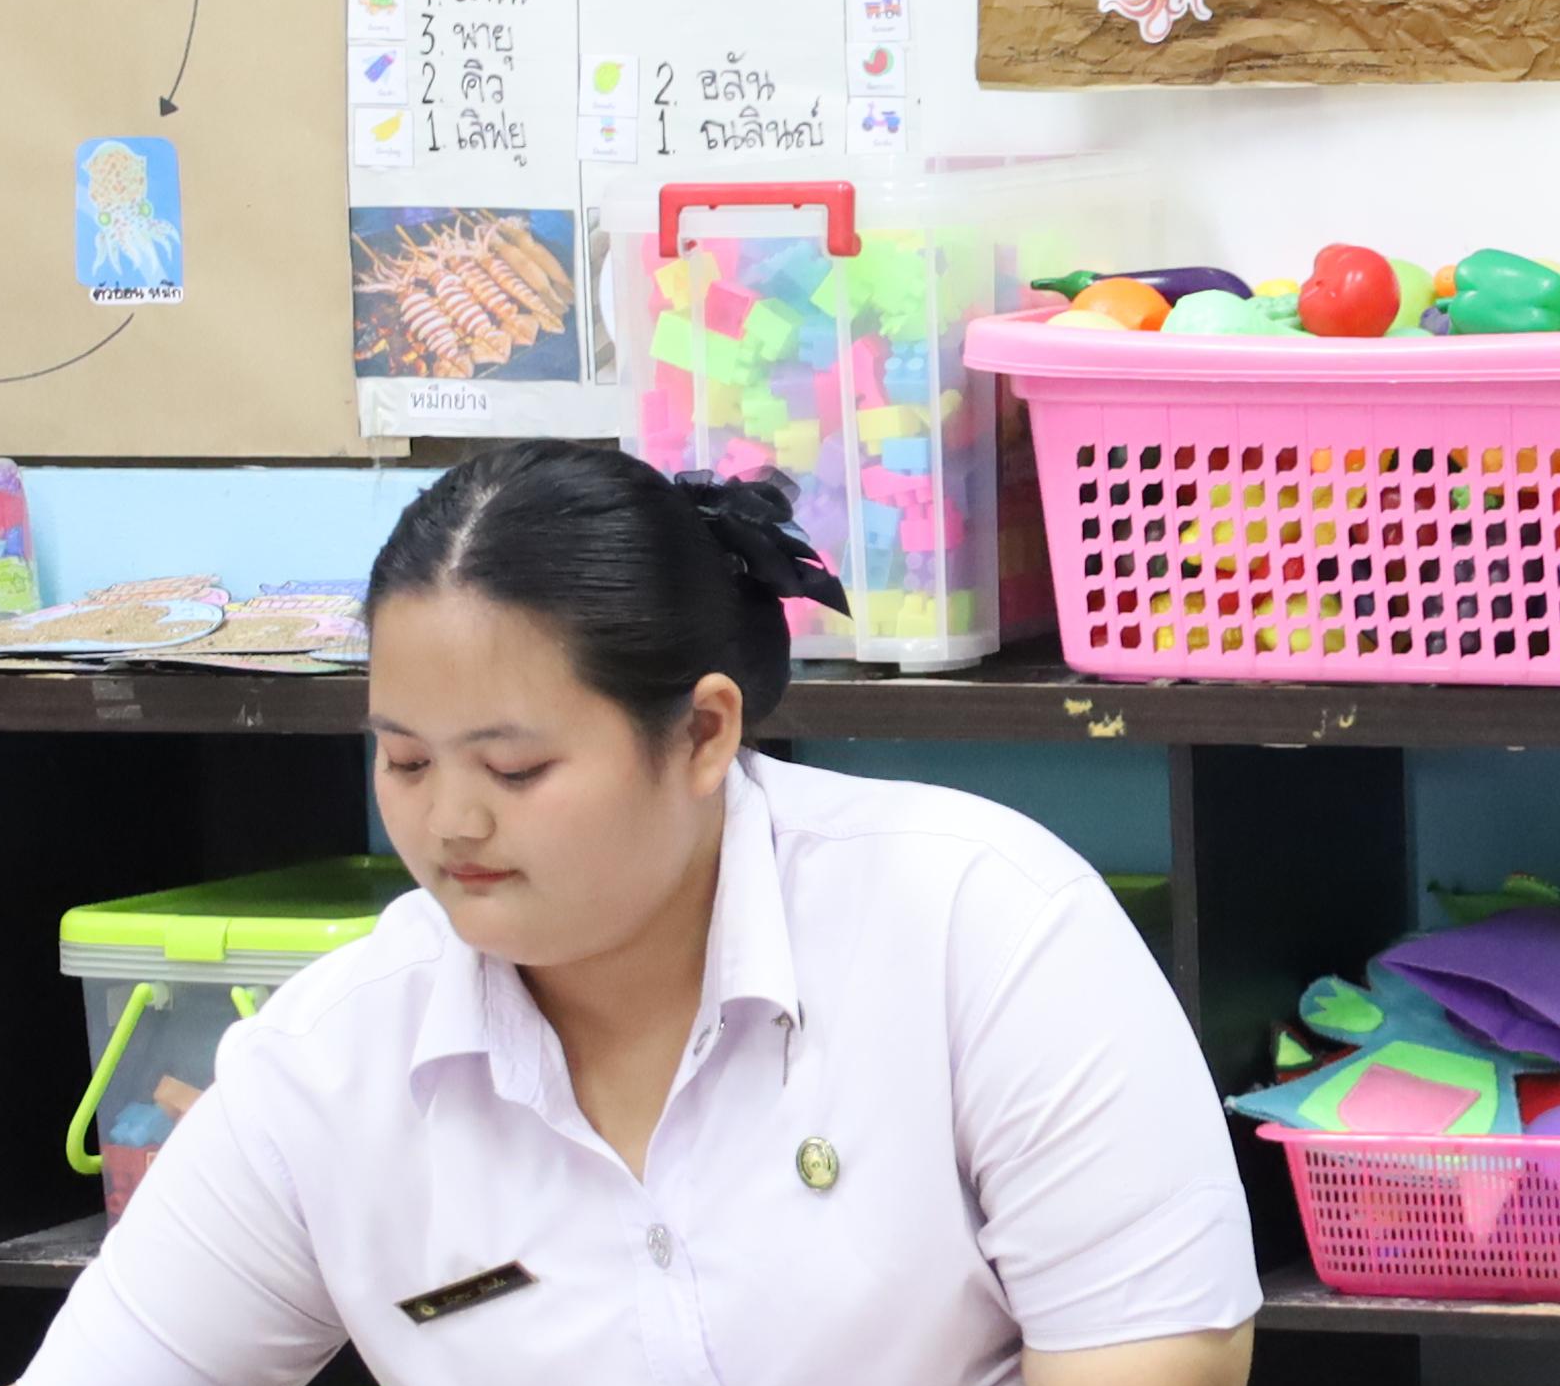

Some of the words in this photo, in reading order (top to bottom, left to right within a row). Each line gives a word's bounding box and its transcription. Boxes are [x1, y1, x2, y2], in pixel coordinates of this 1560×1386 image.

[452, 22, 514, 72] พายุ
[460, 59, 504, 105] คิว
[410, 383, 487, 411] หมึกย่าง
